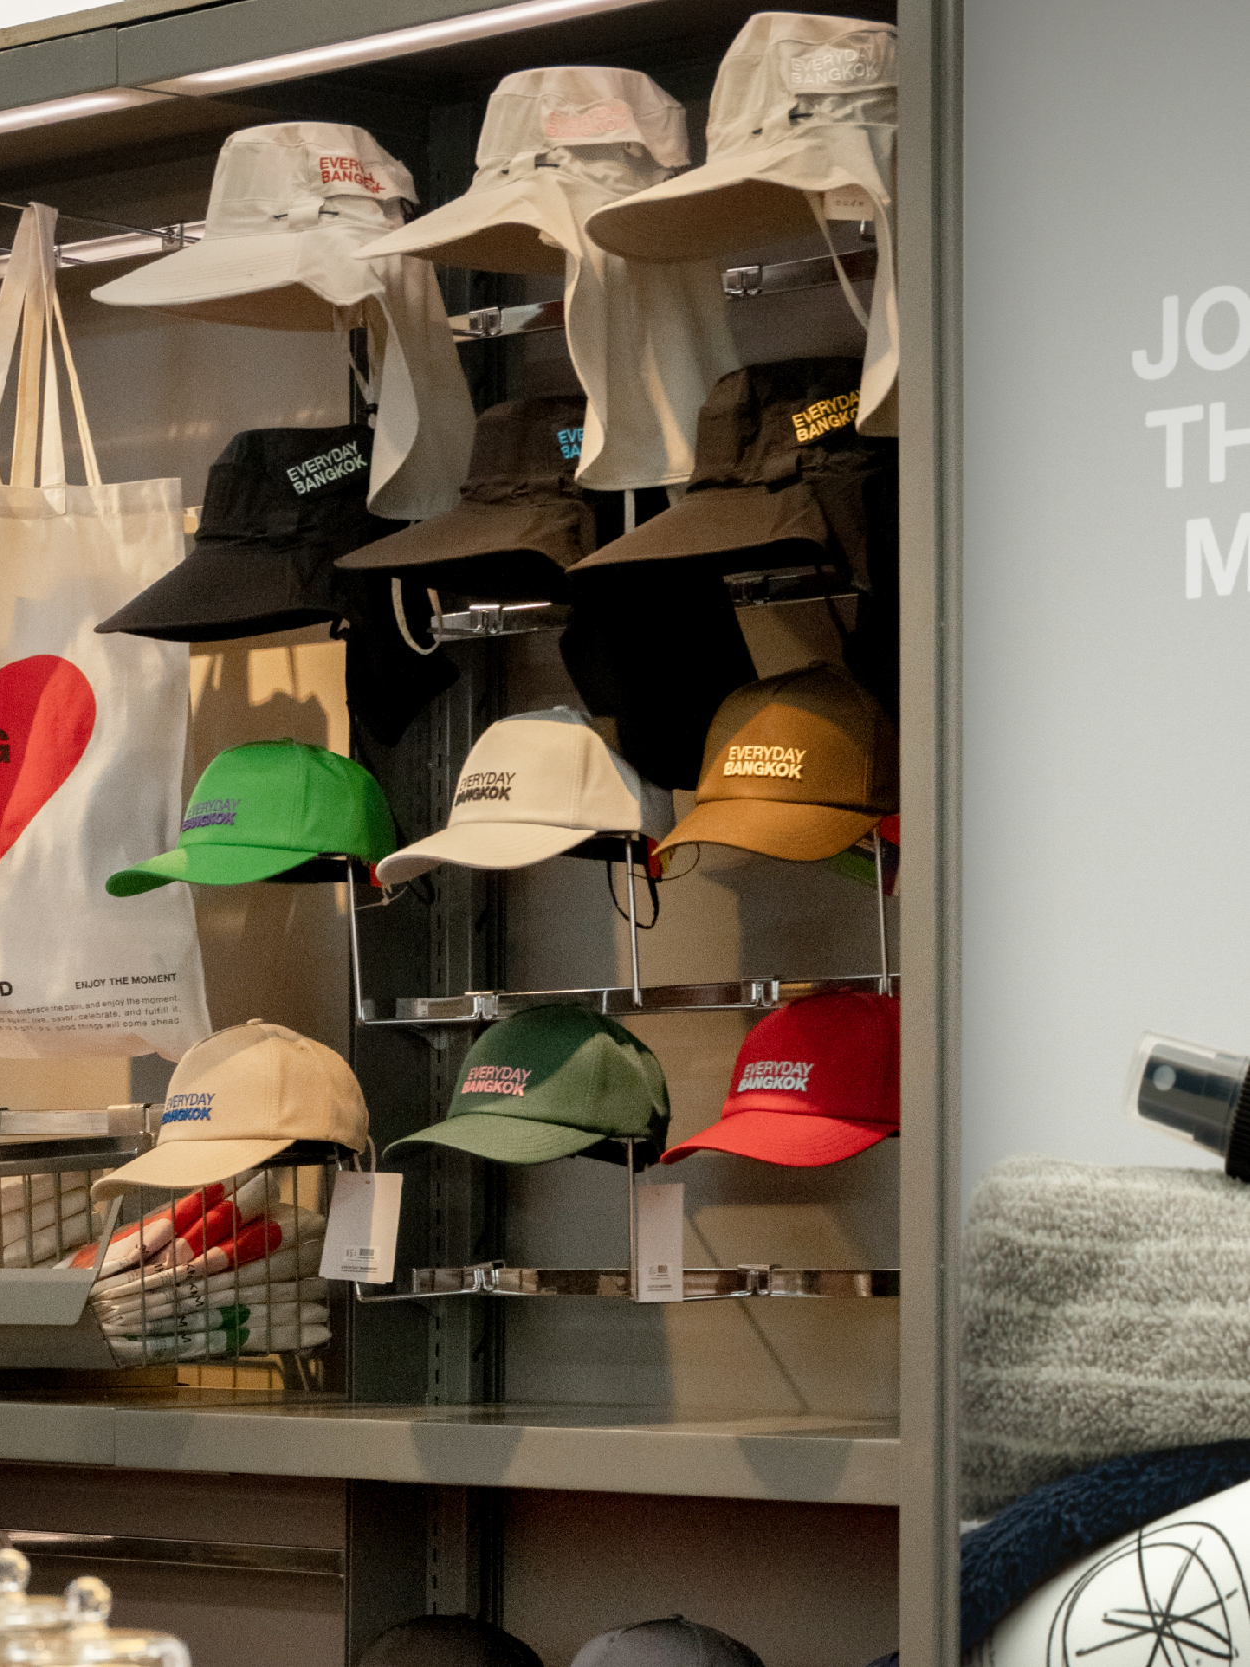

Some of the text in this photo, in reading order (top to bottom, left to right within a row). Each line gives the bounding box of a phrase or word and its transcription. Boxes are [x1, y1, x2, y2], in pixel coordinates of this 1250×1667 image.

[286, 440, 358, 482] EVERYDAY
[293, 454, 368, 495] BANGKOK
[729, 745, 807, 764] EVERYDAY
[723, 760, 803, 779] BANGKOK
[75, 973, 177, 991] ENJOY THE MOMENT
[467, 1065, 532, 1082] EVERYDAY
[743, 1060, 815, 1077] EVERYDAY
[461, 1080, 526, 1097] BANGKOK
[736, 1075, 810, 1092] BANGKOK
